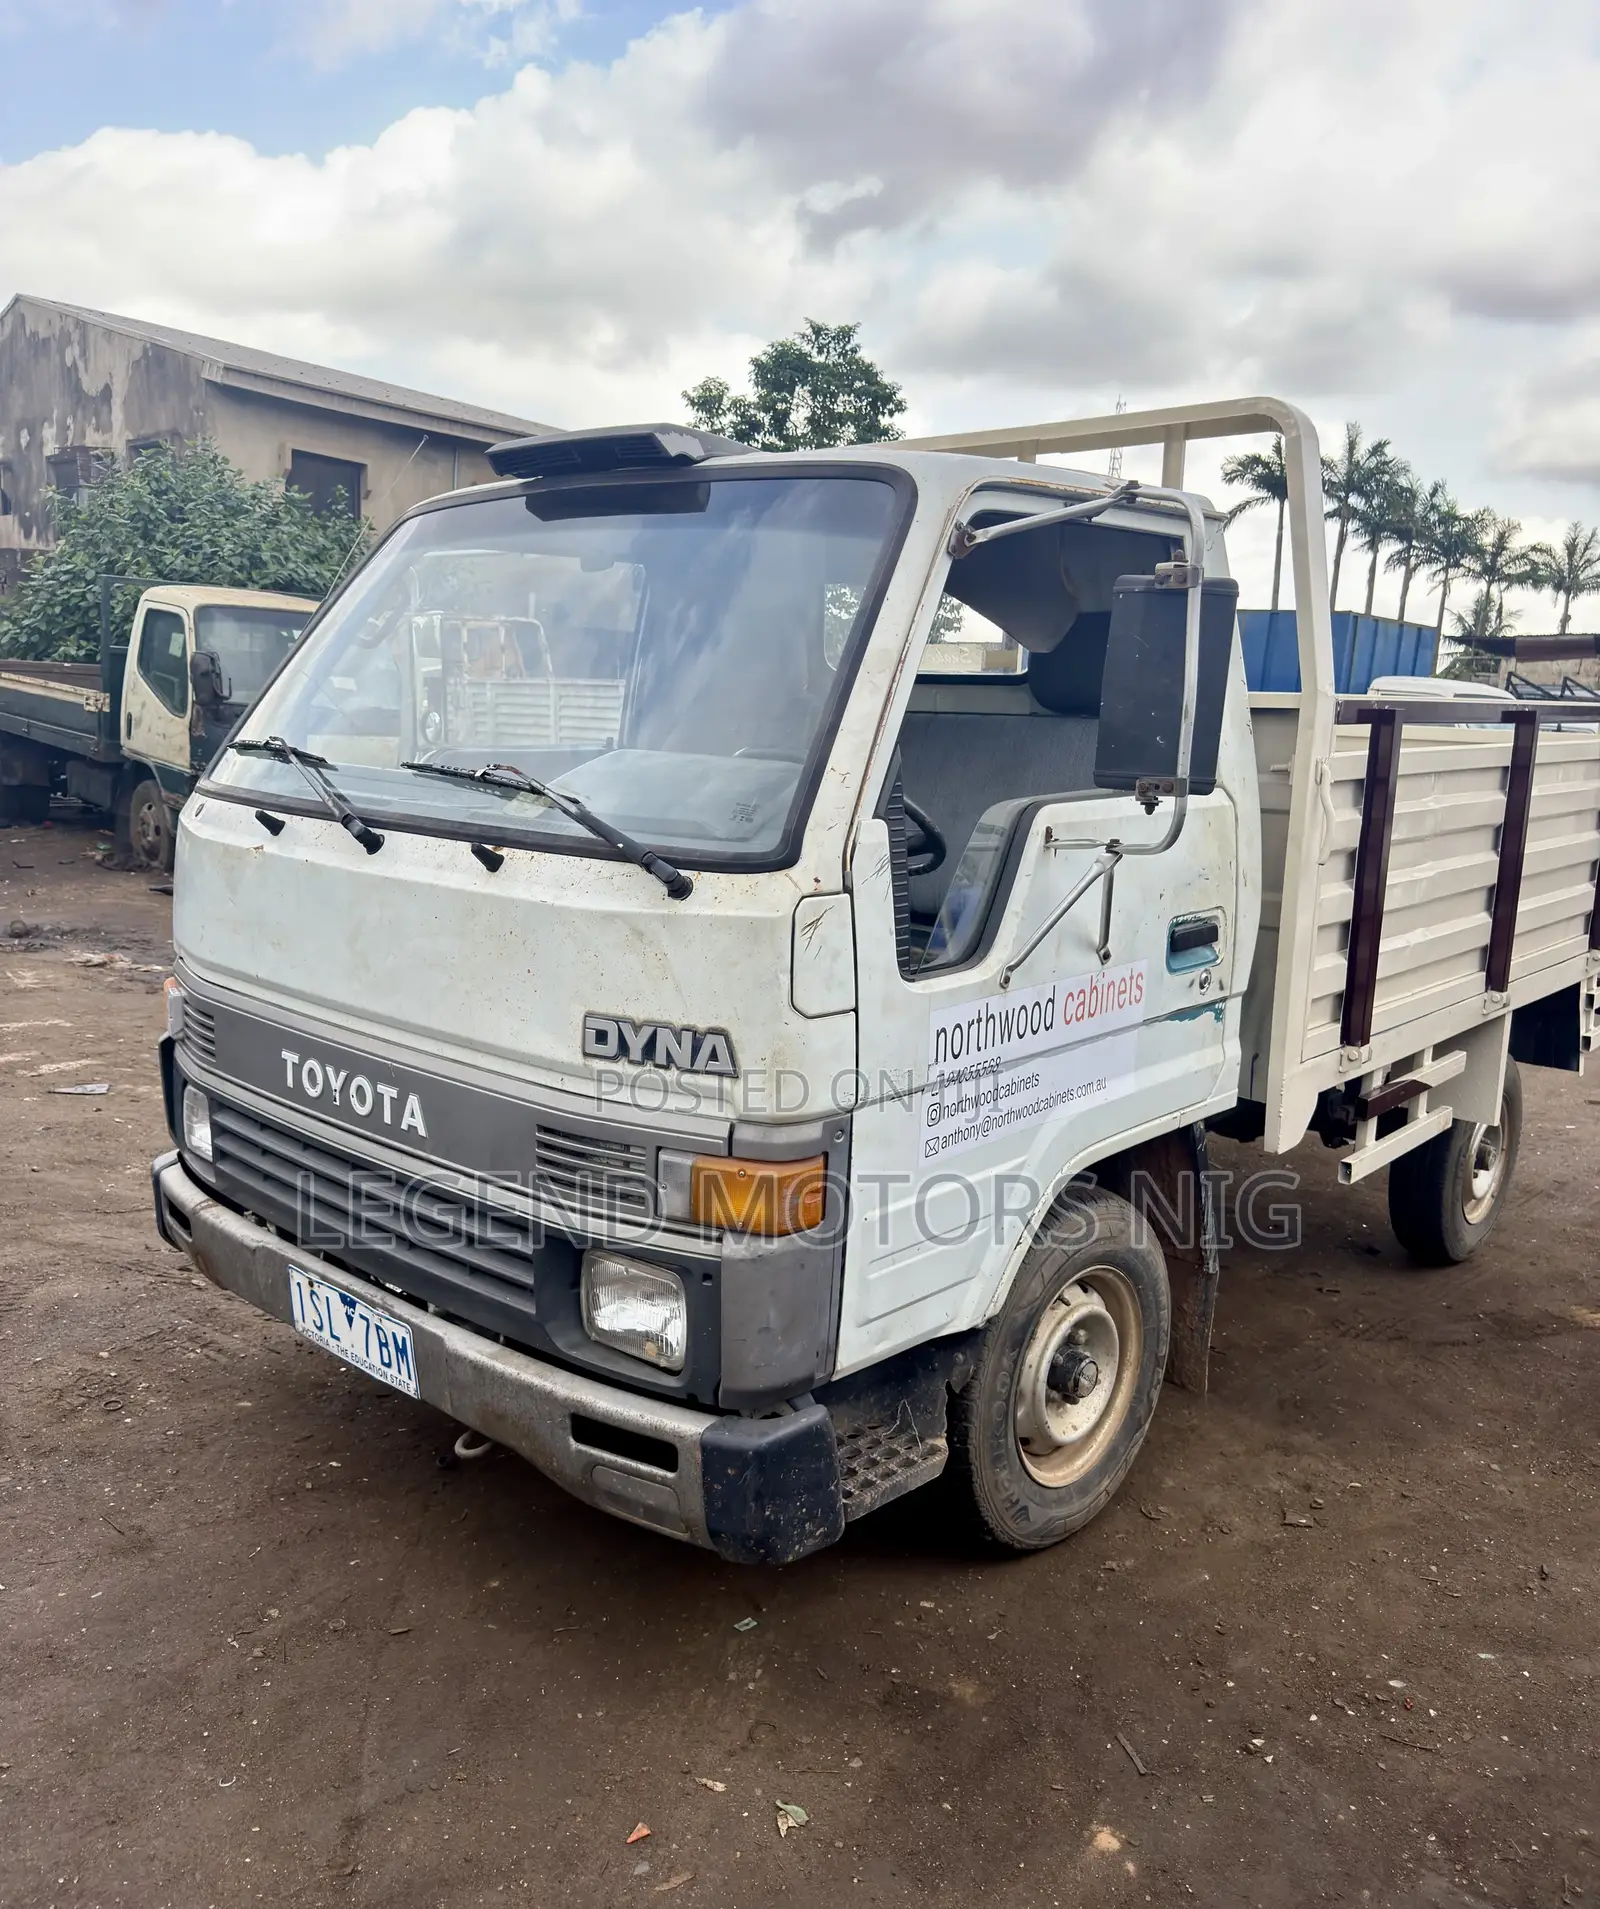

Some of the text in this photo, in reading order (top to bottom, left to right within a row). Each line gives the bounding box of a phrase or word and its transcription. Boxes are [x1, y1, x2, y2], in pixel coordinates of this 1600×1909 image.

[583, 1012, 739, 1078] DYNA
[934, 967, 1144, 1065] northwood cabinets
[281, 1050, 429, 1138] TOYOTA
[941, 1076, 1107, 1150] anthony@northwoodcabinets.com.au
[942, 1072, 1040, 1120] northwoodcabinets
[296, 1281, 413, 1382] 1SL 7BM
[301, 1325, 330, 1347] VICTORIA
[336, 1344, 349, 1358] THE
[351, 1353, 388, 1381] EDUCATION
[390, 1374, 411, 1392] STATE
